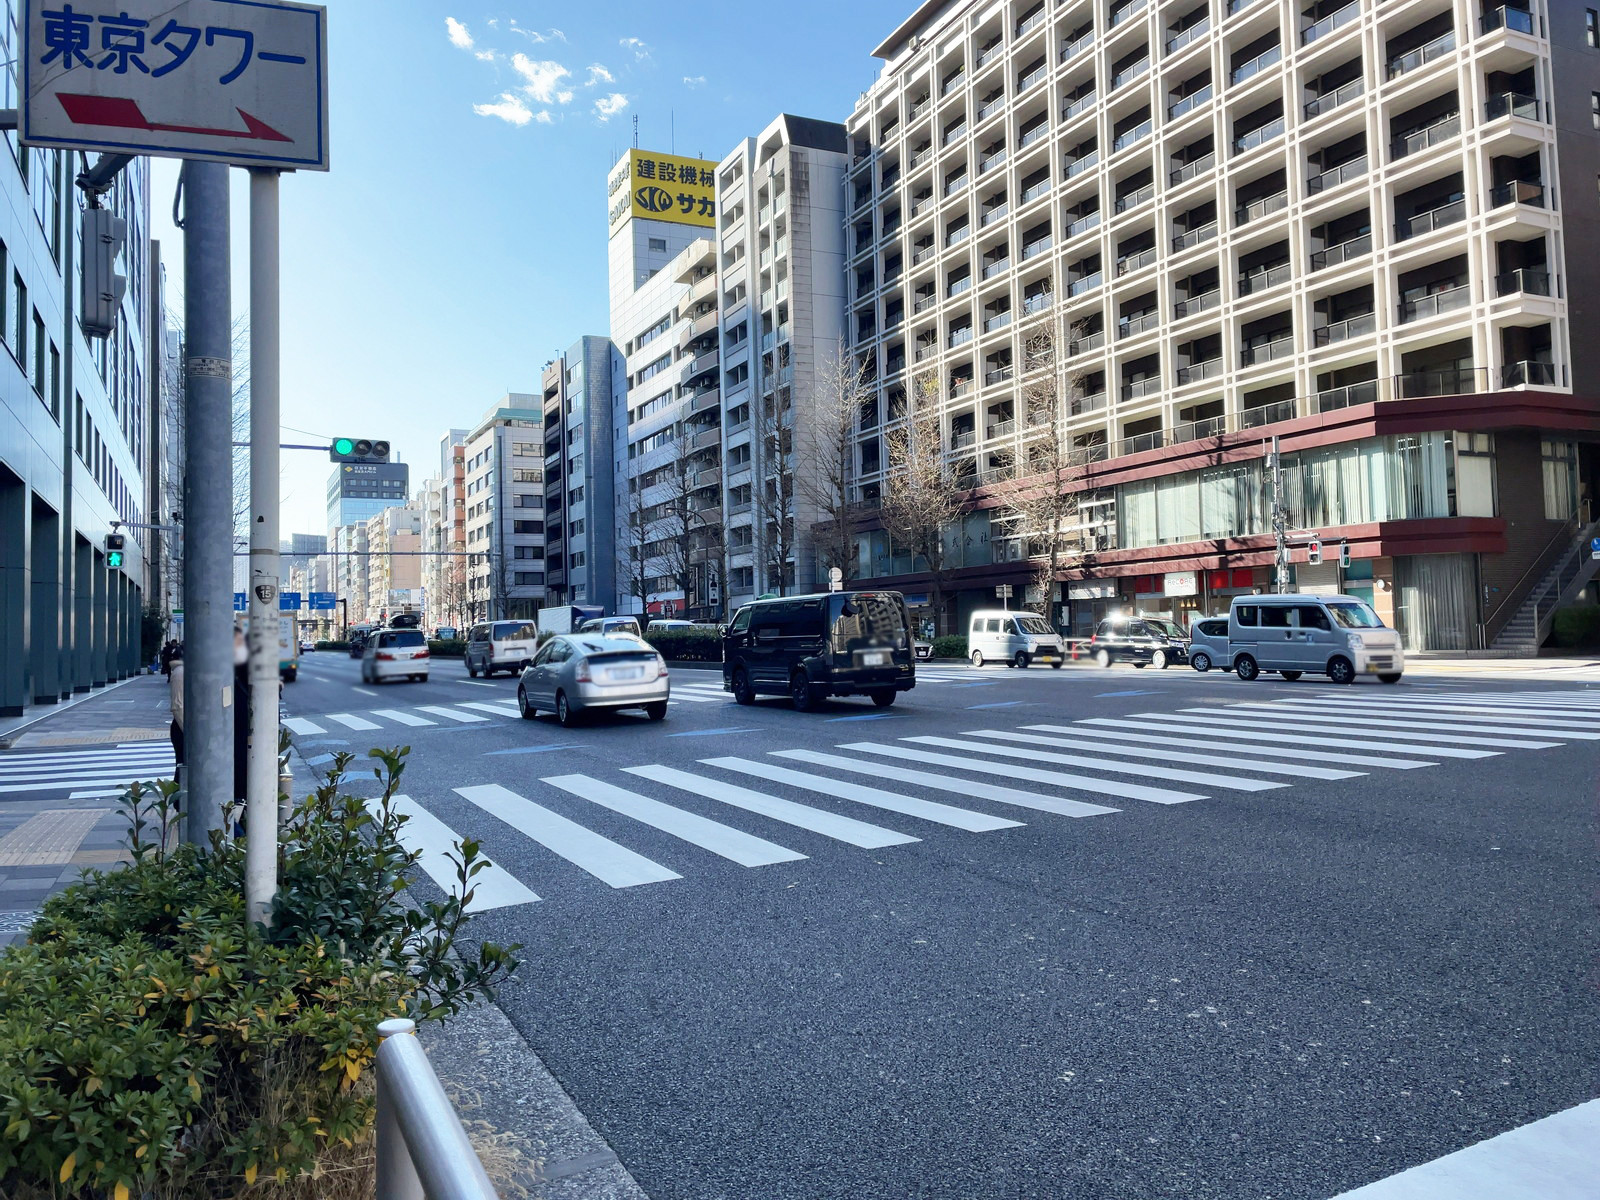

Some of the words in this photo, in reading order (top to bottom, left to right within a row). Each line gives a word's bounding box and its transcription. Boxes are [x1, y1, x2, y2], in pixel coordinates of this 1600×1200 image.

[40, 4, 306, 85] 東京タワー
[637, 158, 715, 188] 建設機械
[677, 193, 716, 218] サカ
[261, 590, 272, 598] 15
